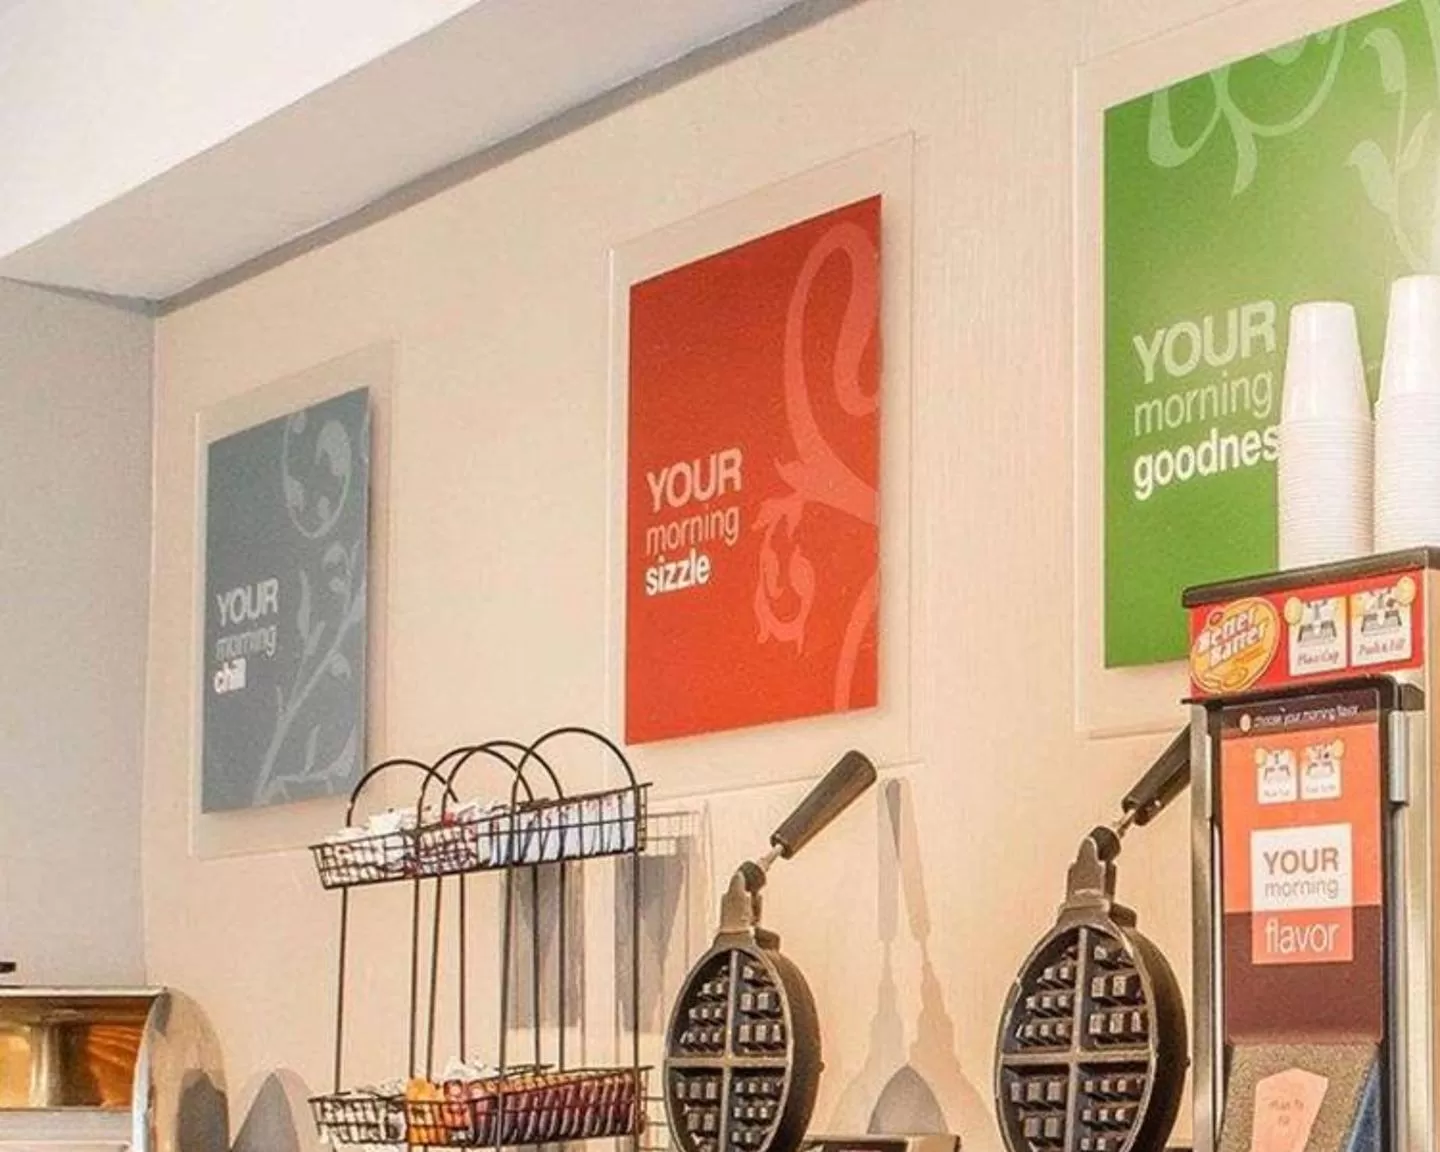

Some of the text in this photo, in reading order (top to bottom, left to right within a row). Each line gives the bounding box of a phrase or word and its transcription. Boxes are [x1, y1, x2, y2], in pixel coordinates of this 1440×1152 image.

[1133, 300, 1276, 384] YOUR
[1134, 369, 1273, 437] morning
[646, 448, 743, 513] YOUR
[646, 504, 740, 557] morning
[645, 548, 711, 596] sizzle
[216, 577, 279, 628] YOUR
[1263, 847, 1339, 875] YOUR
[1264, 878, 1338, 900] morning
[1265, 917, 1340, 954] flavor
